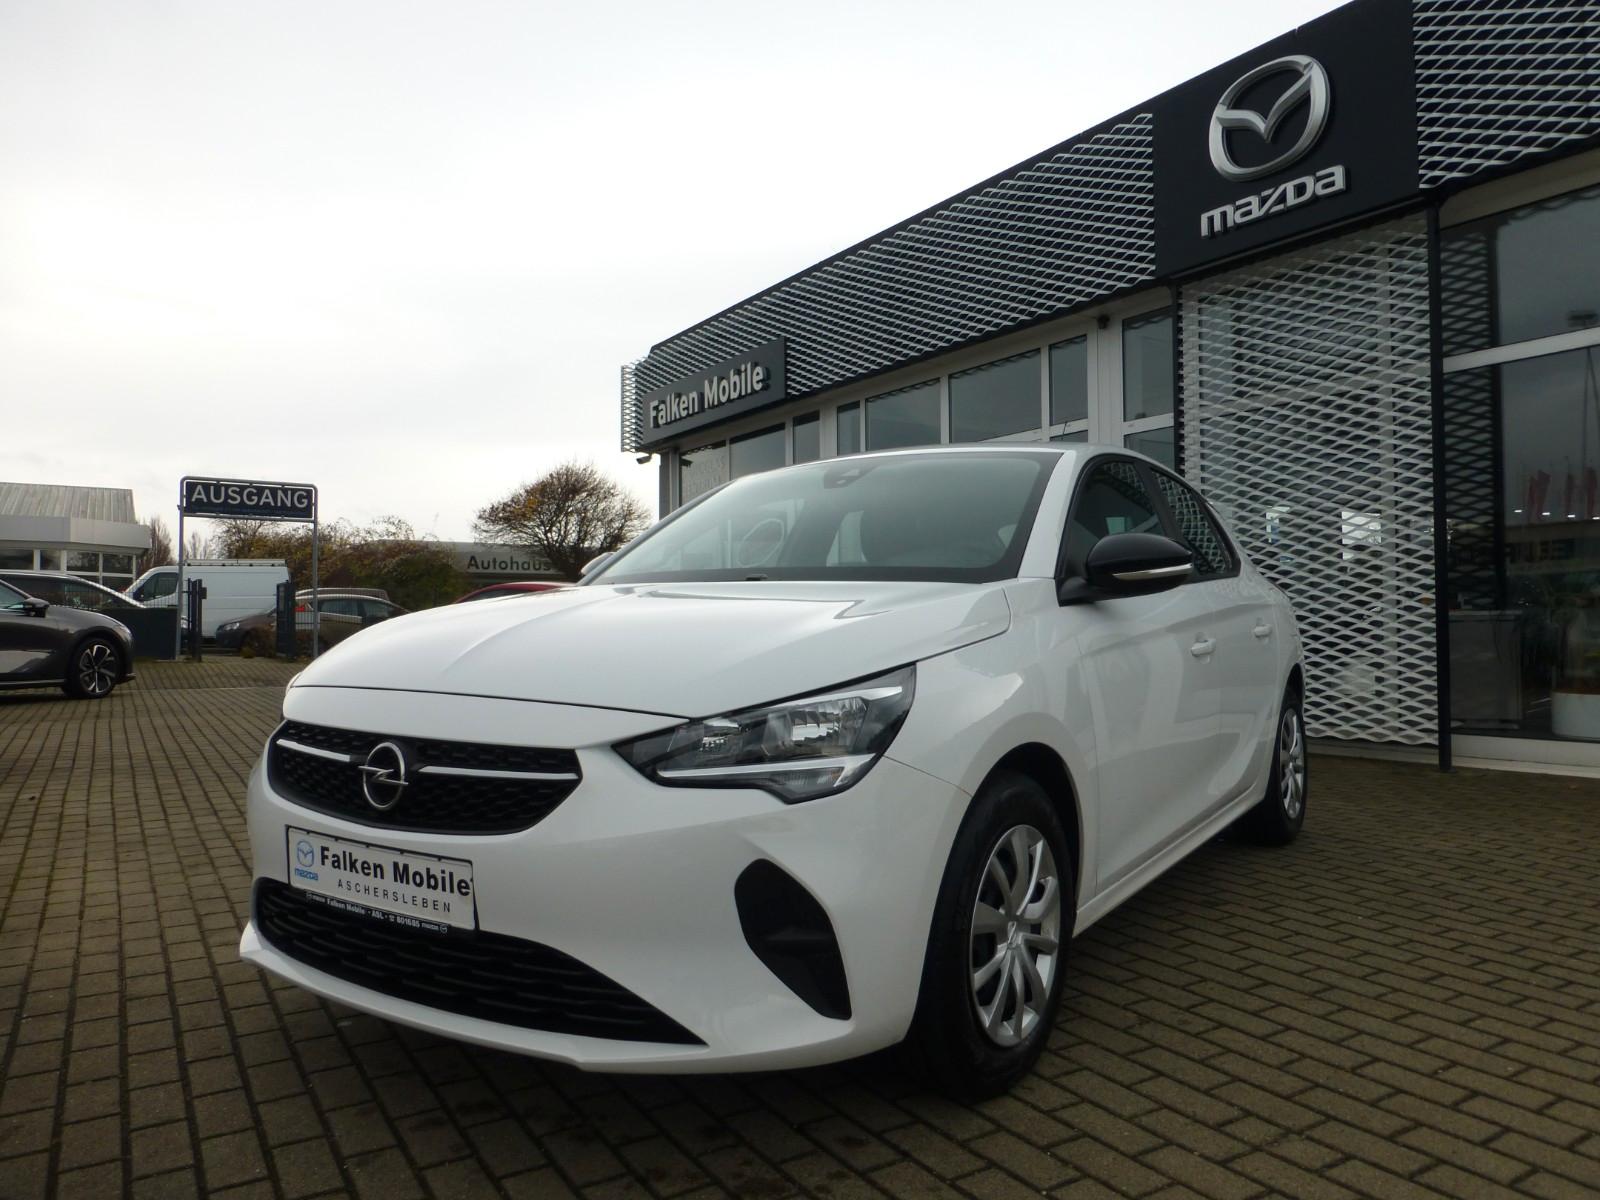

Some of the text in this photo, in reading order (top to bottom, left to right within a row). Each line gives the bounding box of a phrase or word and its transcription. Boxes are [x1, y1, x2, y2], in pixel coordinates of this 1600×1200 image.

[650, 362, 764, 428] Falken Mobile
[191, 484, 308, 508] AUSGANG
[467, 555, 551, 571] Autohaus
[320, 846, 470, 897] Falken Mobile
[338, 879, 451, 913] ASCHERSLEBEN
